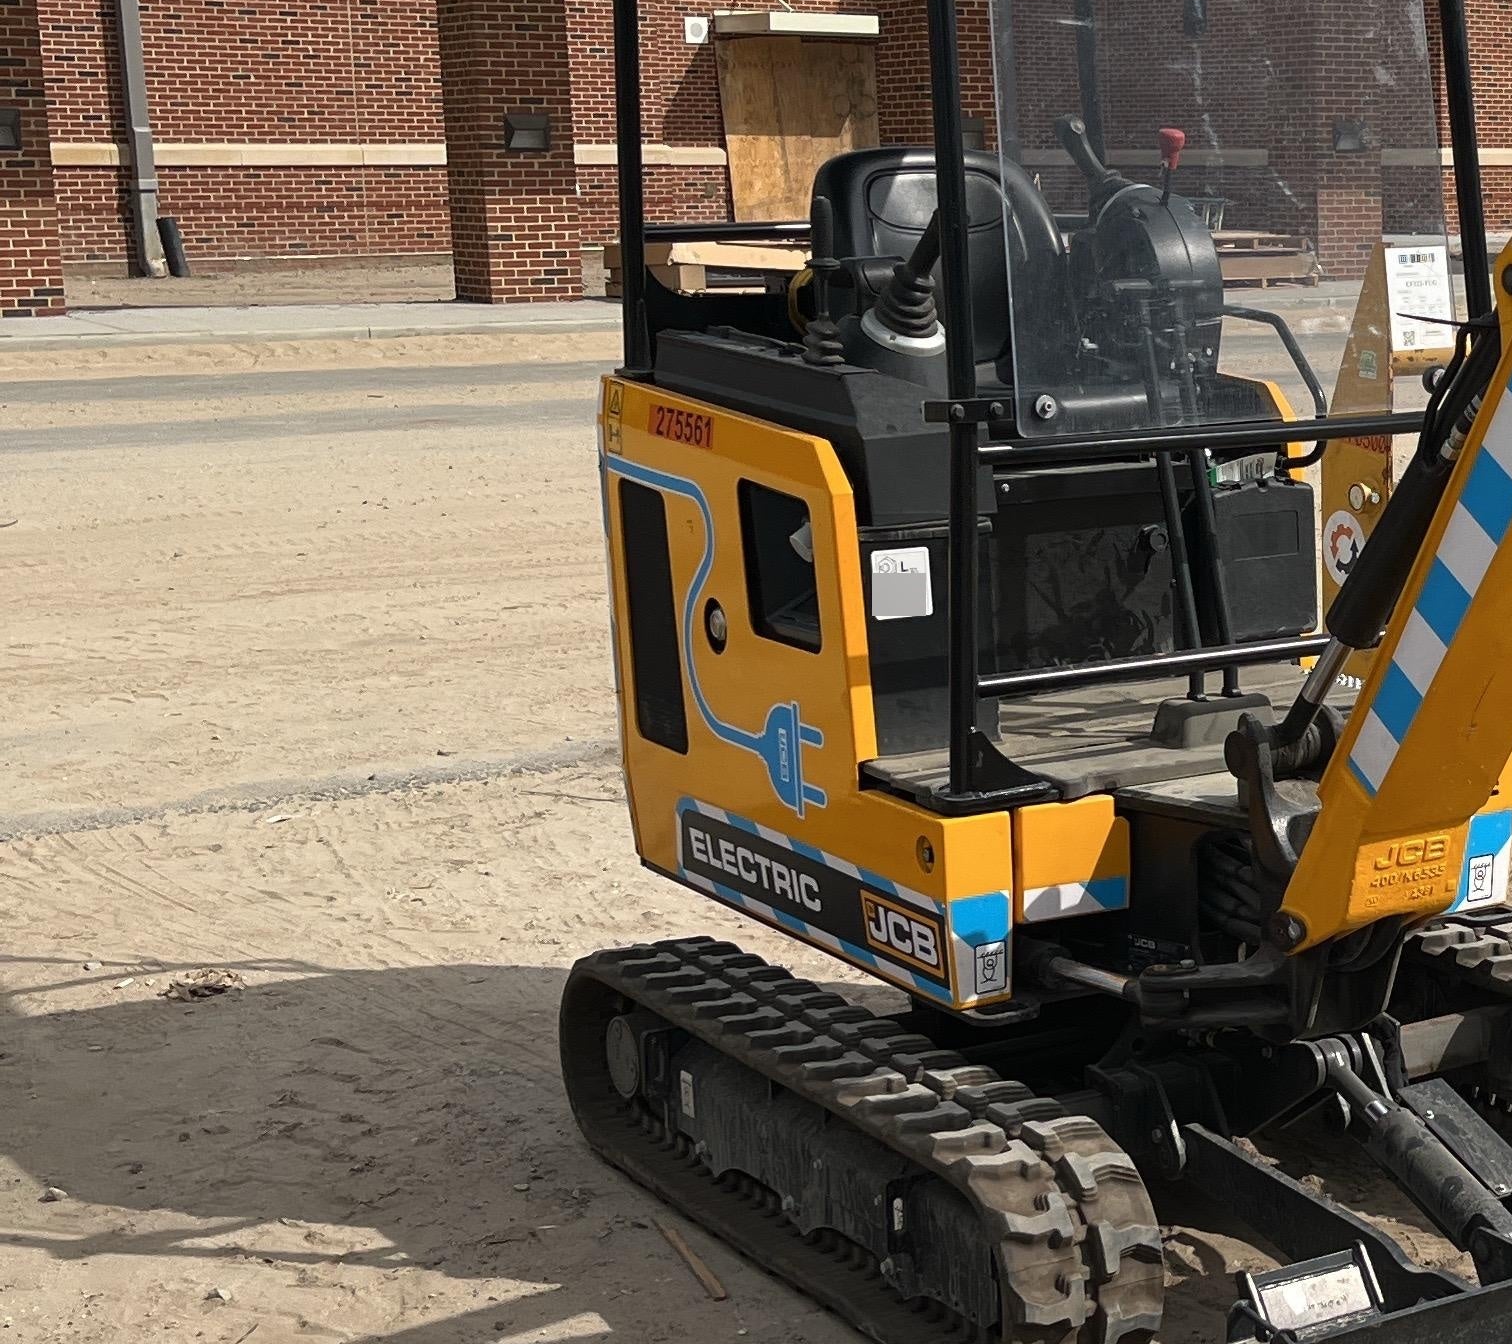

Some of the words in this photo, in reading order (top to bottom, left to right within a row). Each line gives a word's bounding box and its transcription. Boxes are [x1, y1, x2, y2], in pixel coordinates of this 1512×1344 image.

[655, 405, 713, 448] 275561
[688, 826, 823, 913] ELECTRIC
[1373, 835, 1451, 871] JCB
[867, 902, 939, 966] JCB
[1133, 936, 1157, 950] JCB
